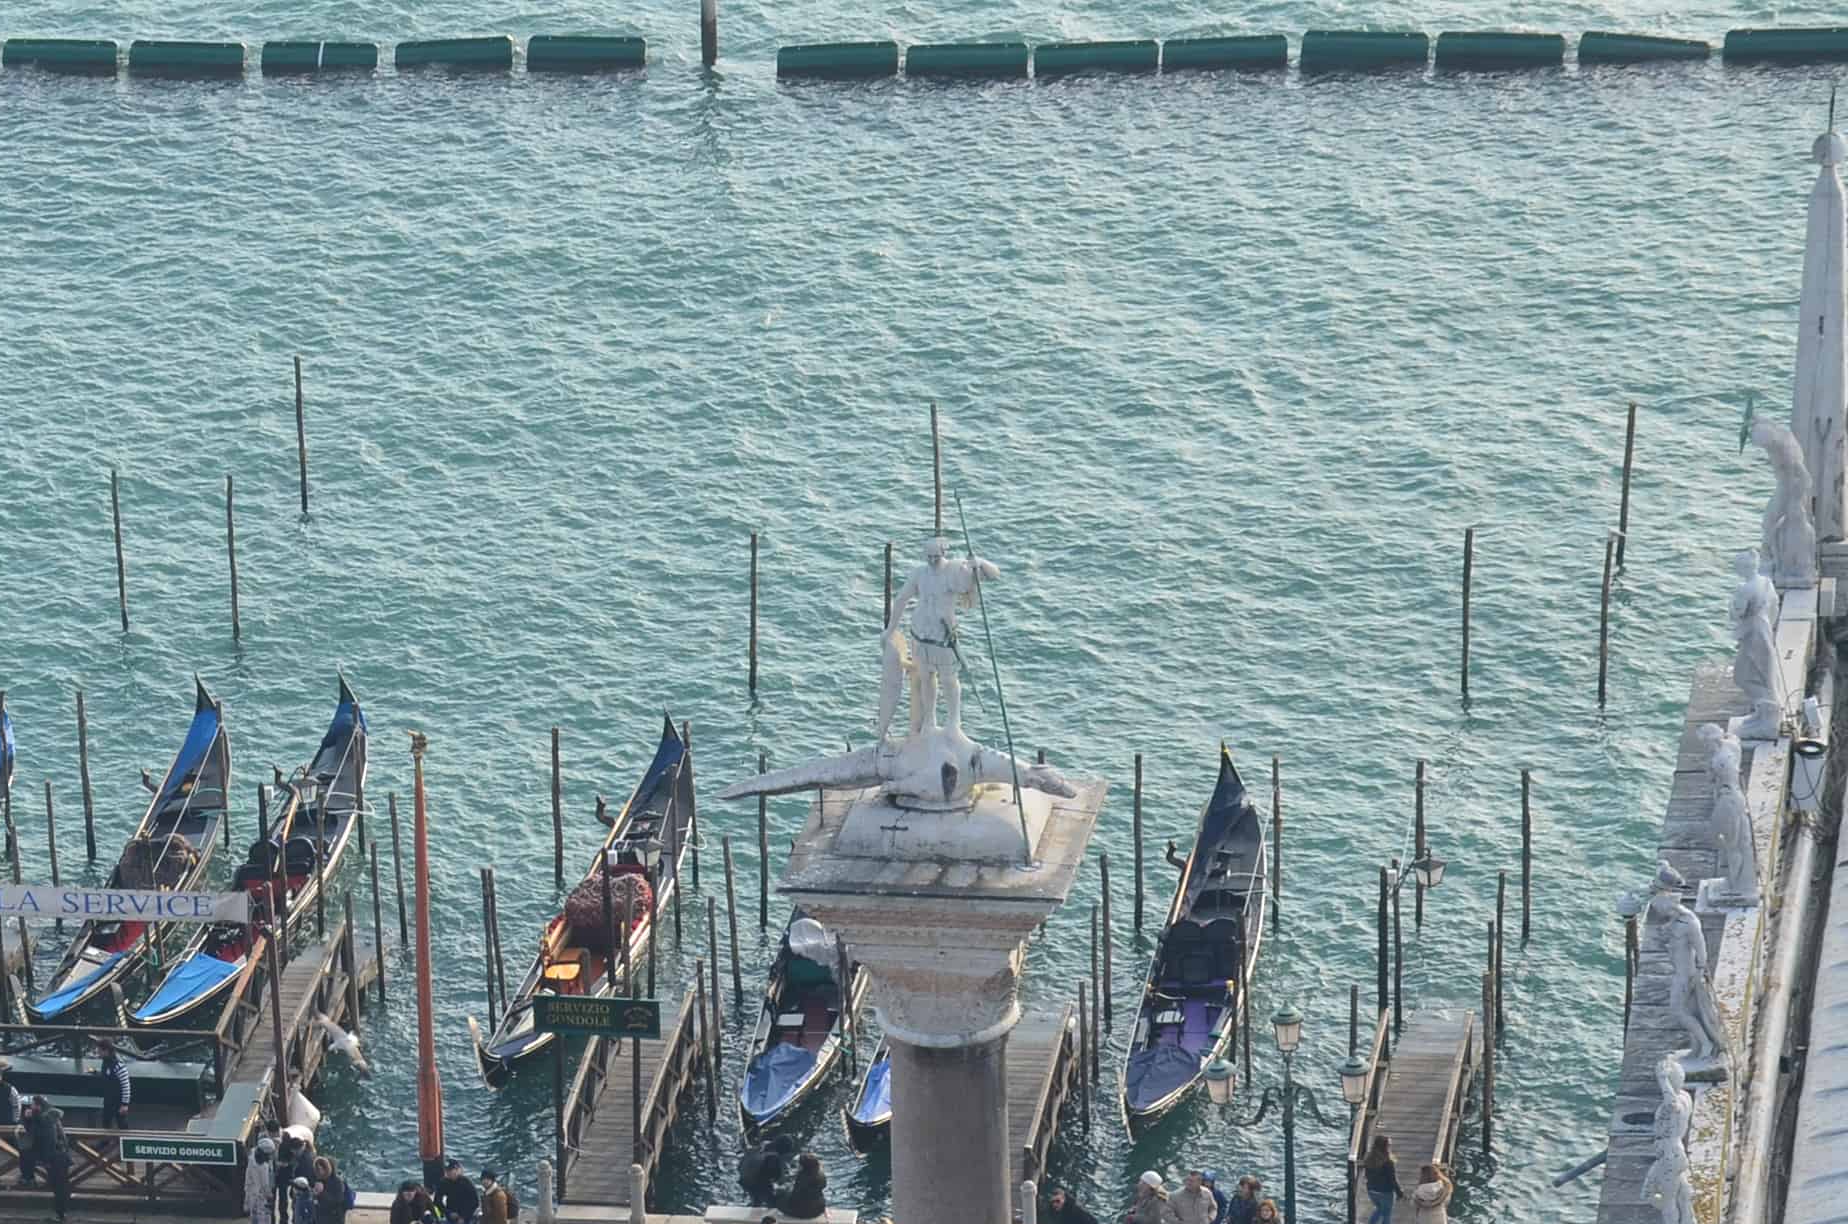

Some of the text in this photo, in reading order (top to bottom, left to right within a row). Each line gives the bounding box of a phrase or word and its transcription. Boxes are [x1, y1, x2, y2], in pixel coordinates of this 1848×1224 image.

[62, 892, 213, 917] SERVICE
[547, 1002, 610, 1014] SERVIZIO
[547, 1014, 610, 1026] GONDOLE
[135, 1144, 223, 1158] SERVIZIO GONDOLE
